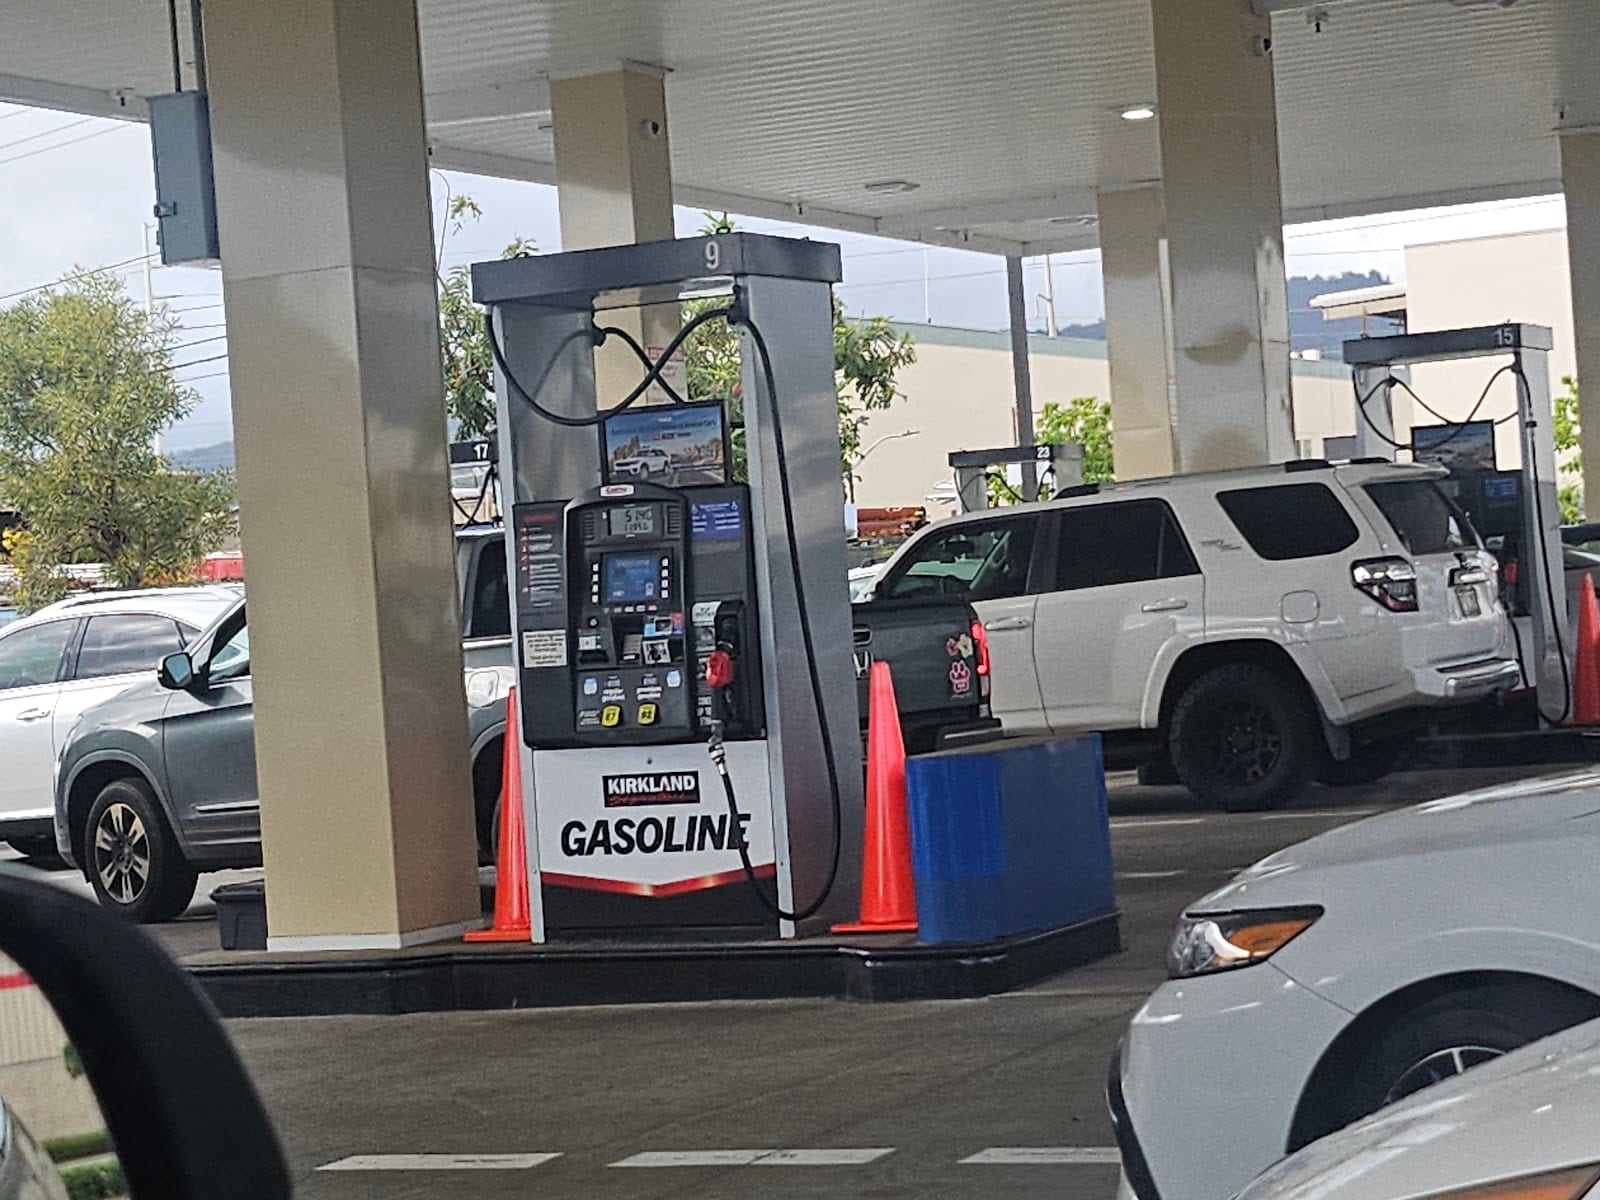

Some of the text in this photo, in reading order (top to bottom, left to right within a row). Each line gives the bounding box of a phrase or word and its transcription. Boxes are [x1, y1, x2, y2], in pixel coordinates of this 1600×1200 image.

[706, 241, 719, 270] 9
[1494, 327, 1514, 345] 15
[473, 443, 488, 459] 17
[607, 774, 696, 795] KIRKLAND
[560, 813, 751, 857] GASOLINE
